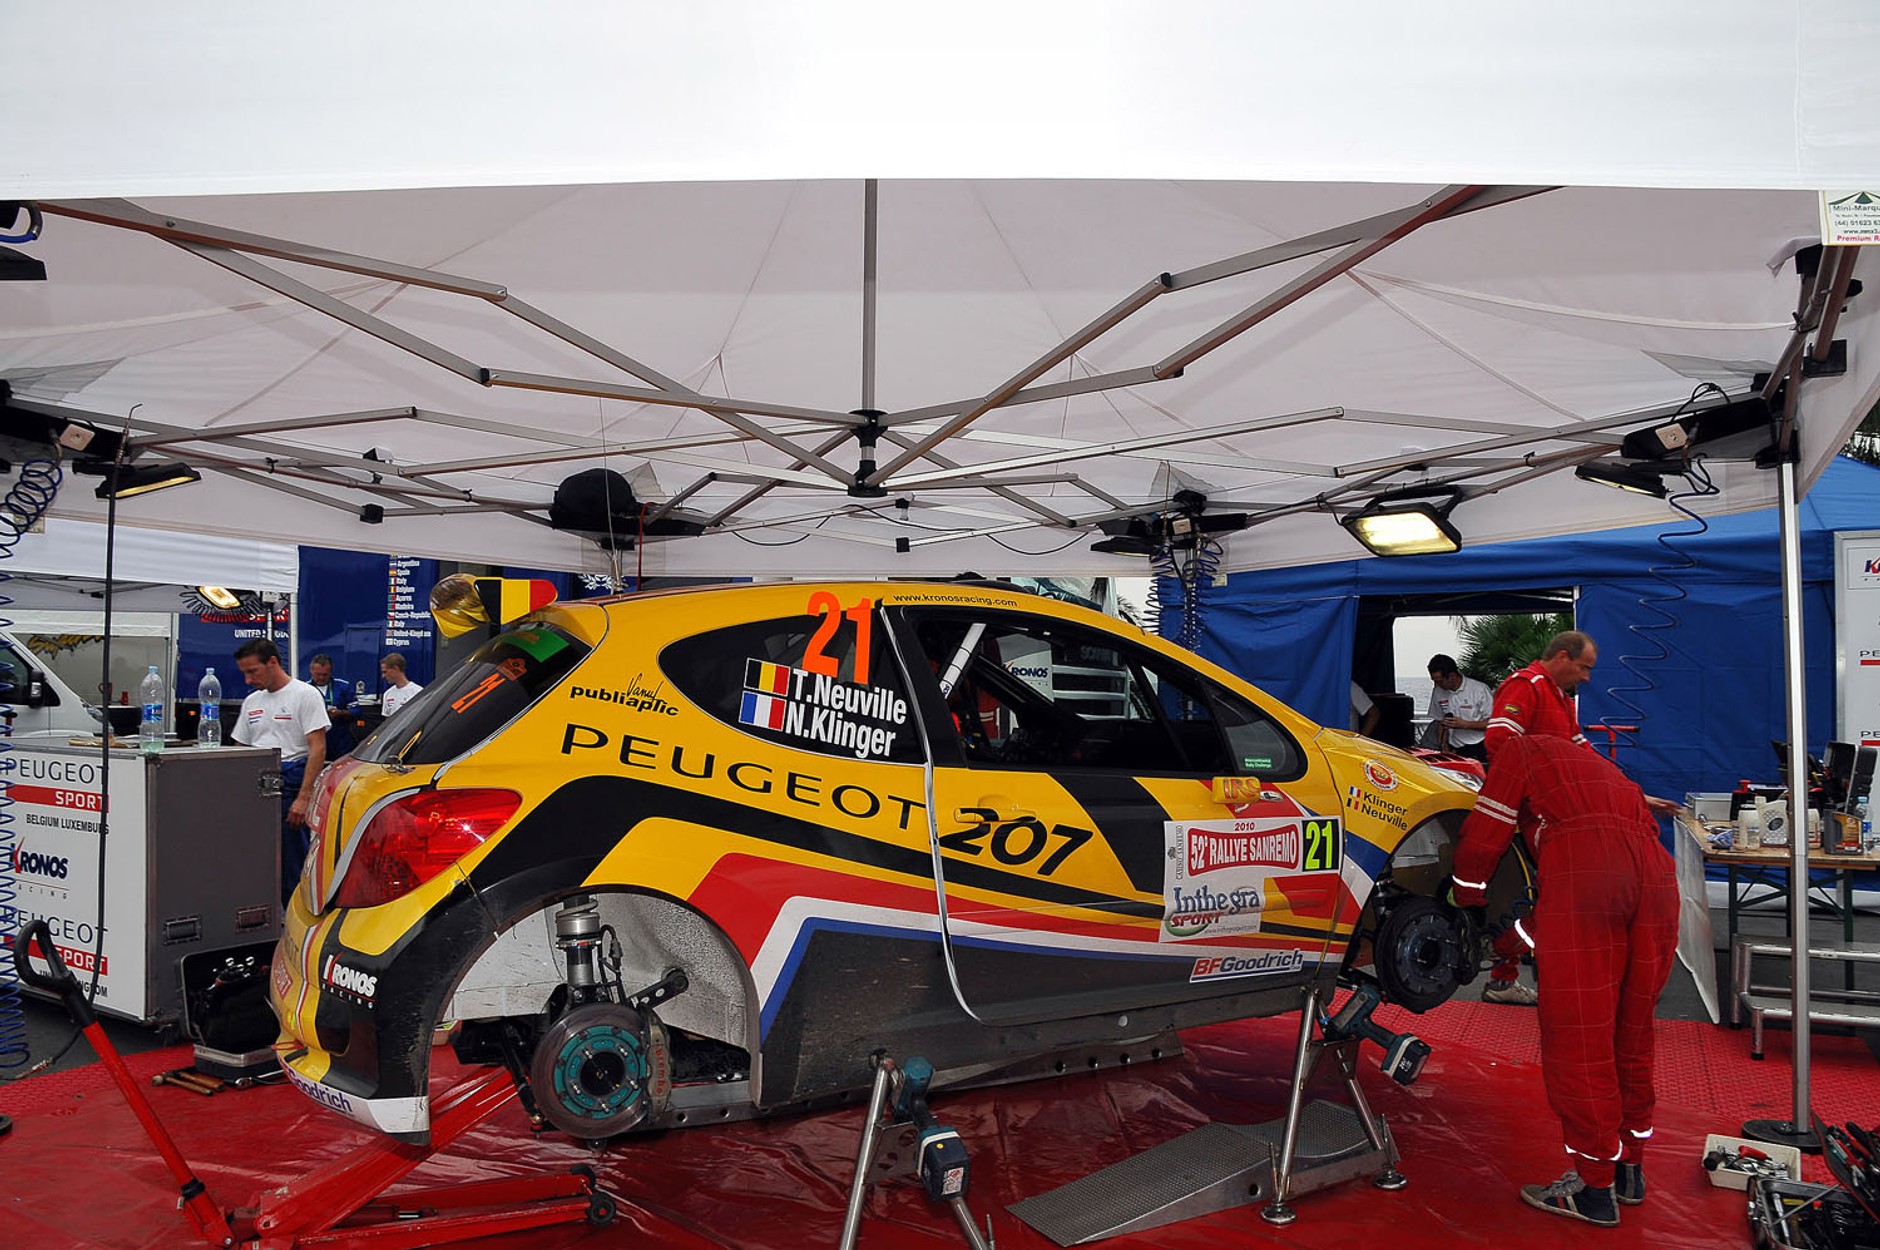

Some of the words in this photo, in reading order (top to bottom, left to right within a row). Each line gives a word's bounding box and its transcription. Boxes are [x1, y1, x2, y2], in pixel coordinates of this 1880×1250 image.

[893, 593, 1018, 607] www.kronosracing.com
[801, 590, 872, 685] 21
[792, 668, 907, 724] T.Neuville
[785, 701, 897, 759] N.Klinger
[561, 723, 926, 830] PEUGEOT
[26, 813, 59, 828] BELGIUM
[1361, 801, 1408, 831] Neuville
[1363, 791, 1408, 816] Klinger
[939, 808, 1093, 876] 207
[1234, 822, 1255, 832] 2010
[1210, 835, 1248, 865] RALLYE
[1249, 831, 1296, 864] SANREMO
[1305, 821, 1333, 870] 21
[1171, 912, 1224, 927] SPORT
[323, 952, 377, 997] KRONOS
[1194, 948, 1303, 976] BFGoodrich
[322, 984, 374, 1009] RACING
[279, 1062, 353, 1114] Goodrich
